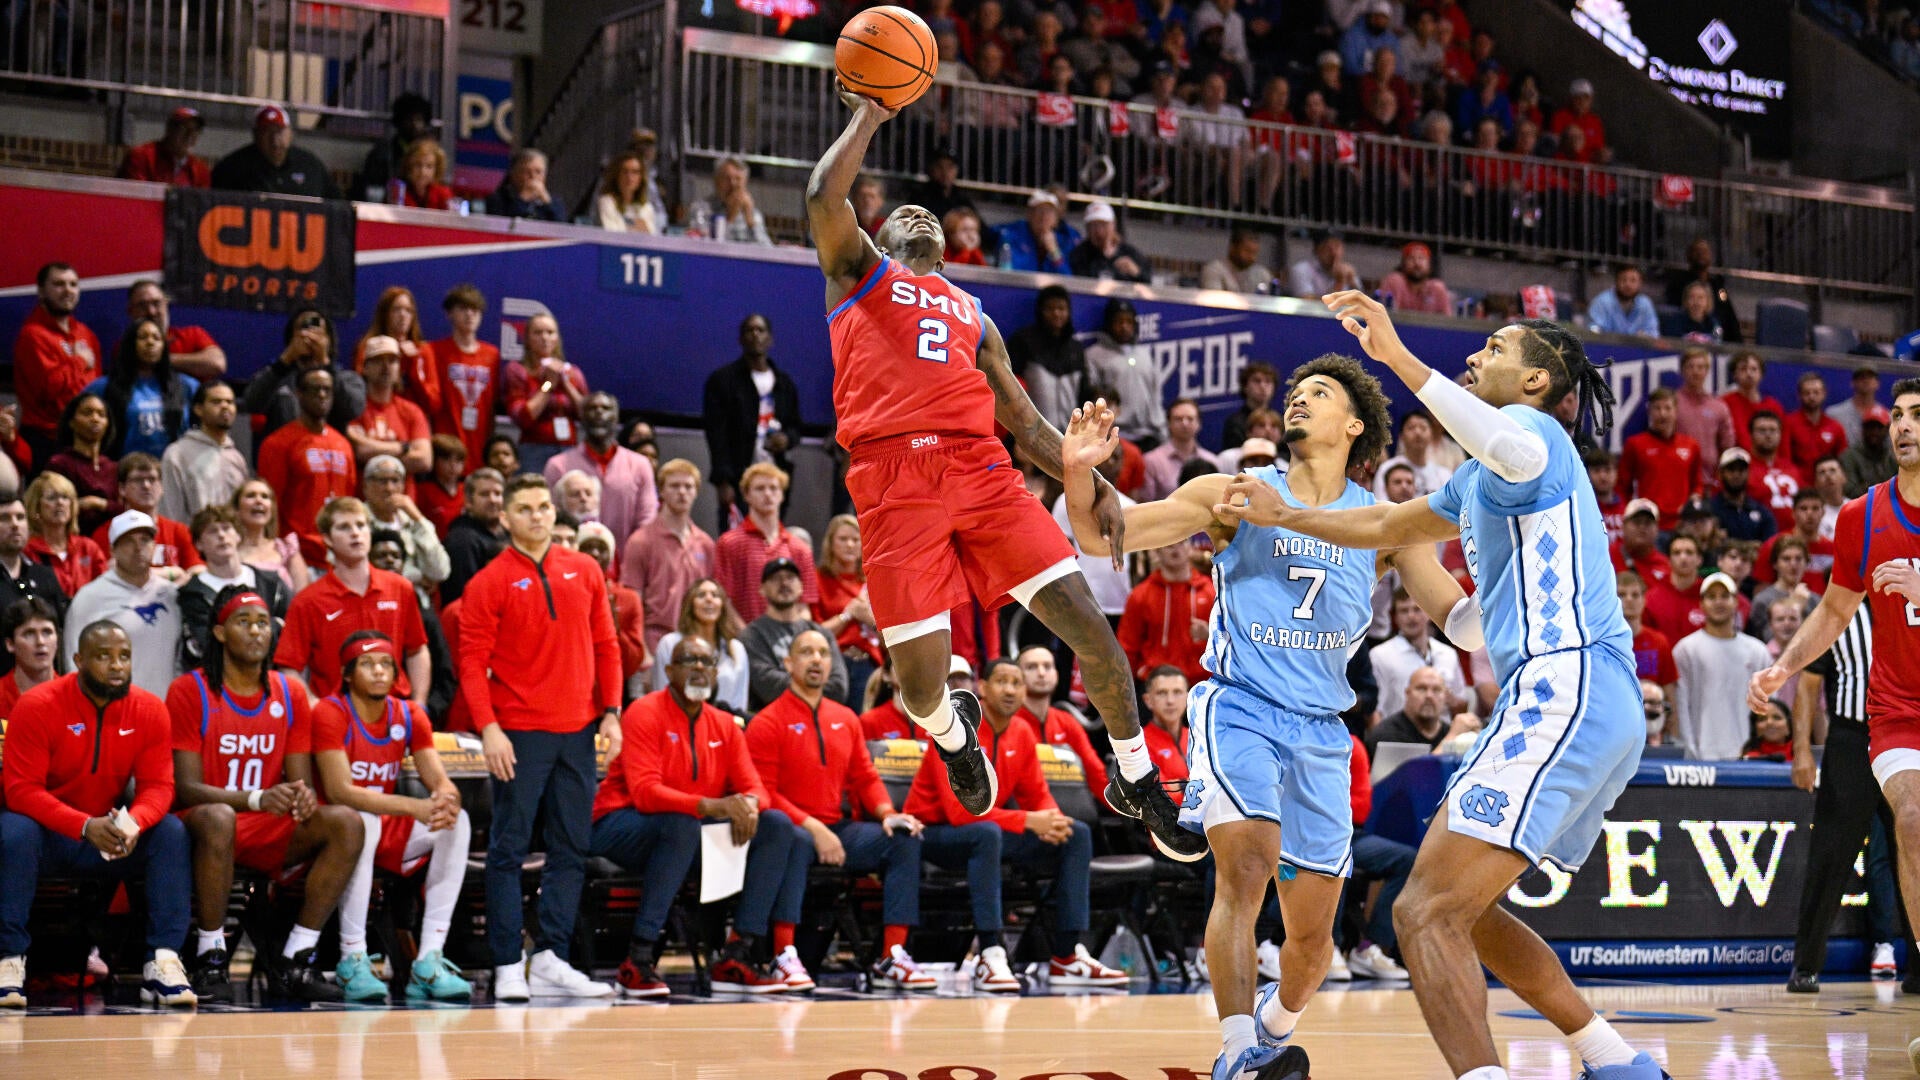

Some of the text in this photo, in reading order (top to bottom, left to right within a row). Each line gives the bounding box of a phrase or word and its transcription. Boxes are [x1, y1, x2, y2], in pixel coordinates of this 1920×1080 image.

[461, 0, 525, 33] 212
[198, 205, 326, 274] CW
[620, 253, 663, 288] 111
[203, 272, 319, 300] SPORTS
[891, 280, 973, 325] SMU
[917, 317, 949, 364] 2
[1136, 312, 1162, 341] HE
[911, 435, 938, 448] SMU
[1273, 537, 1345, 567] NORTH
[1287, 565, 1327, 620] 7
[1250, 622, 1347, 650] CAROLINA
[219, 733, 275, 755] SMU
[225, 758, 264, 791] 10
[351, 760, 400, 781] SMU
[1664, 765, 1717, 786] UTSW
[1712, 944, 1769, 965] Medical
